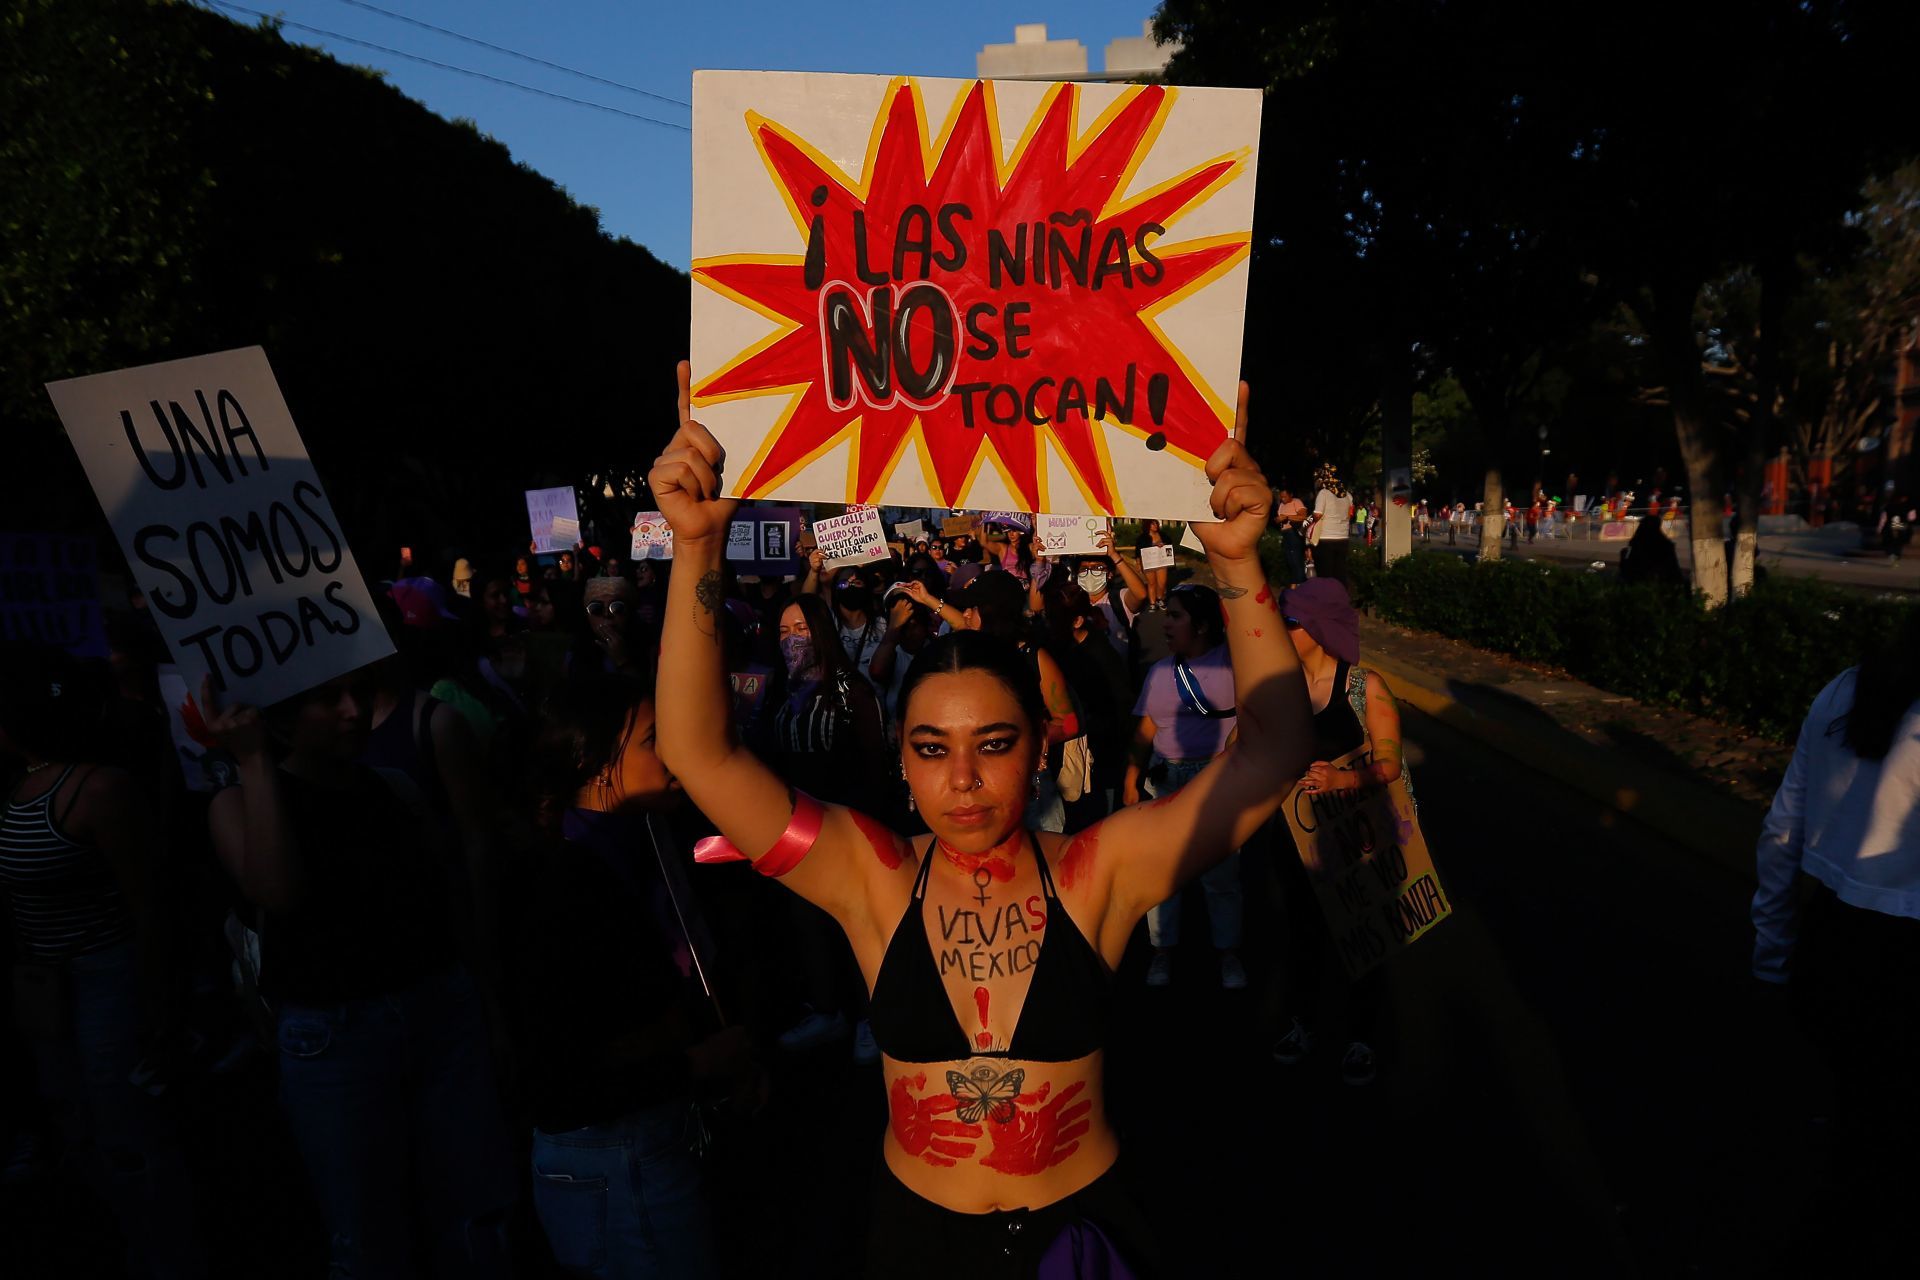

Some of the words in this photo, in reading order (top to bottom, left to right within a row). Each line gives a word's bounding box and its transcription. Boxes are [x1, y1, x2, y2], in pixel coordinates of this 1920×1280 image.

[987, 209, 1165, 290] NIÑAS
[821, 281, 961, 410] NO
[966, 302, 1032, 361] SE
[951, 363, 1170, 451] TOCAN!
[120, 389, 269, 490] UNA
[816, 522, 827, 533] EN
[830, 519, 841, 530] LA
[840, 512, 865, 527] CALLE
[818, 530, 848, 543] QUIERO
[848, 526, 864, 540] SER
[852, 532, 878, 547] QUIERO
[134, 481, 342, 619] SOMOS
[842, 546, 864, 557] LIBRE
[869, 546, 883, 557] 8M
[179, 581, 360, 692] TODAS
[1333, 809, 1376, 866] NO
[1369, 843, 1408, 891] VEO
[938, 896, 1047, 946] VIVAS
[1383, 874, 1446, 944] BONITA
[940, 940, 1043, 982] MÉXICO
